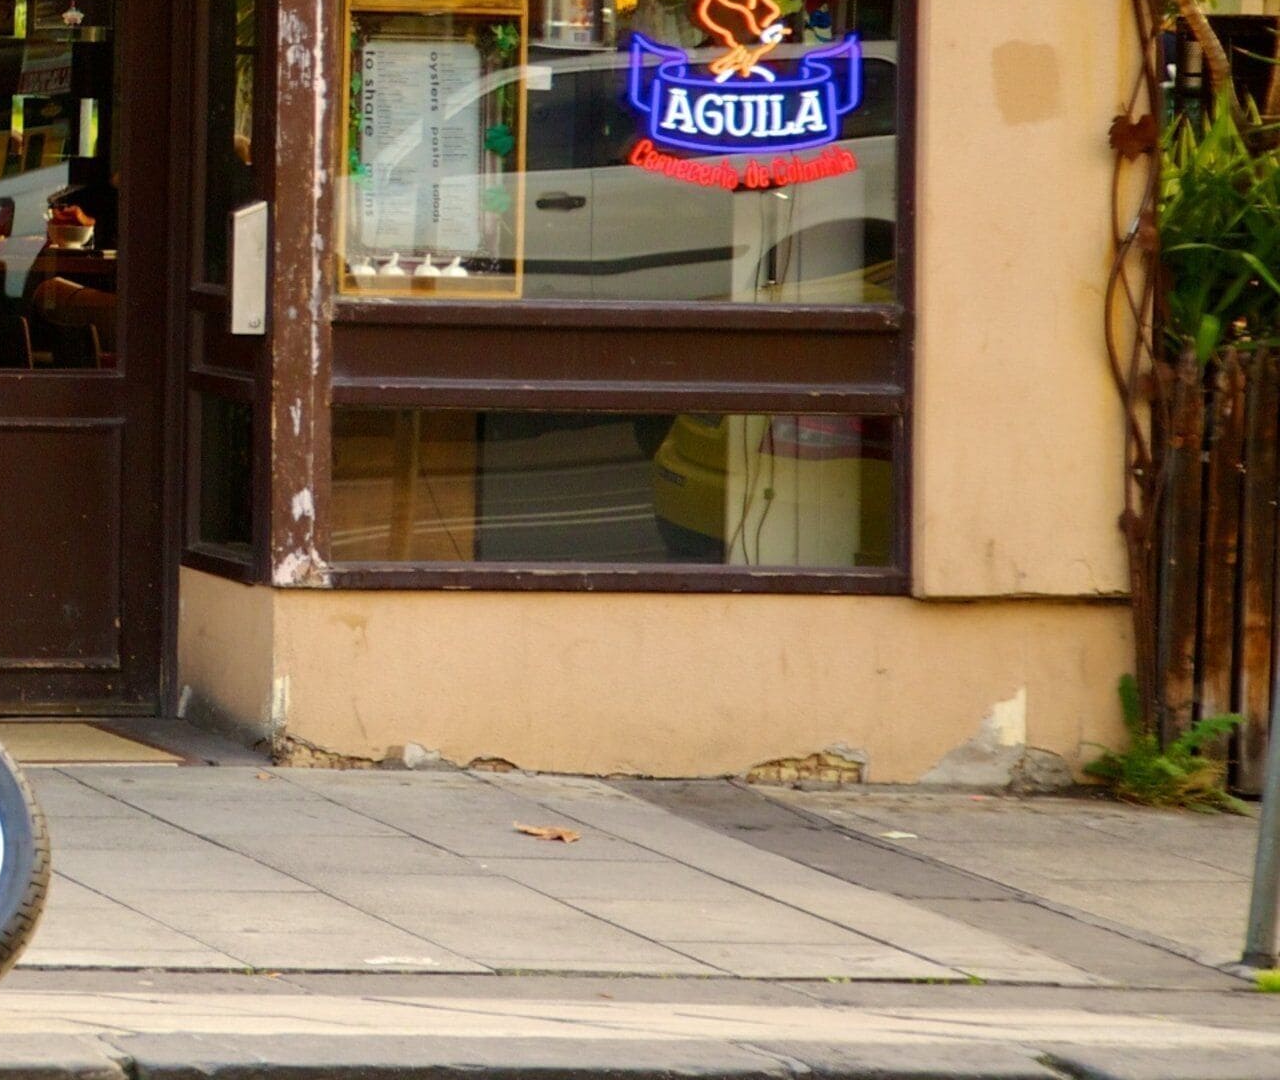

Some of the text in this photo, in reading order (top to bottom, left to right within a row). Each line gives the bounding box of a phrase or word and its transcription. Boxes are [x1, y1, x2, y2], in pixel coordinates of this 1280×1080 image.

[365, 51, 376, 137] to share
[428, 52, 440, 112] oysters
[660, 88, 827, 137] AGUILA
[430, 127, 439, 168] pasta
[366, 163, 375, 217] mins
[744, 159, 770, 189] de
[432, 184, 440, 223] salads
